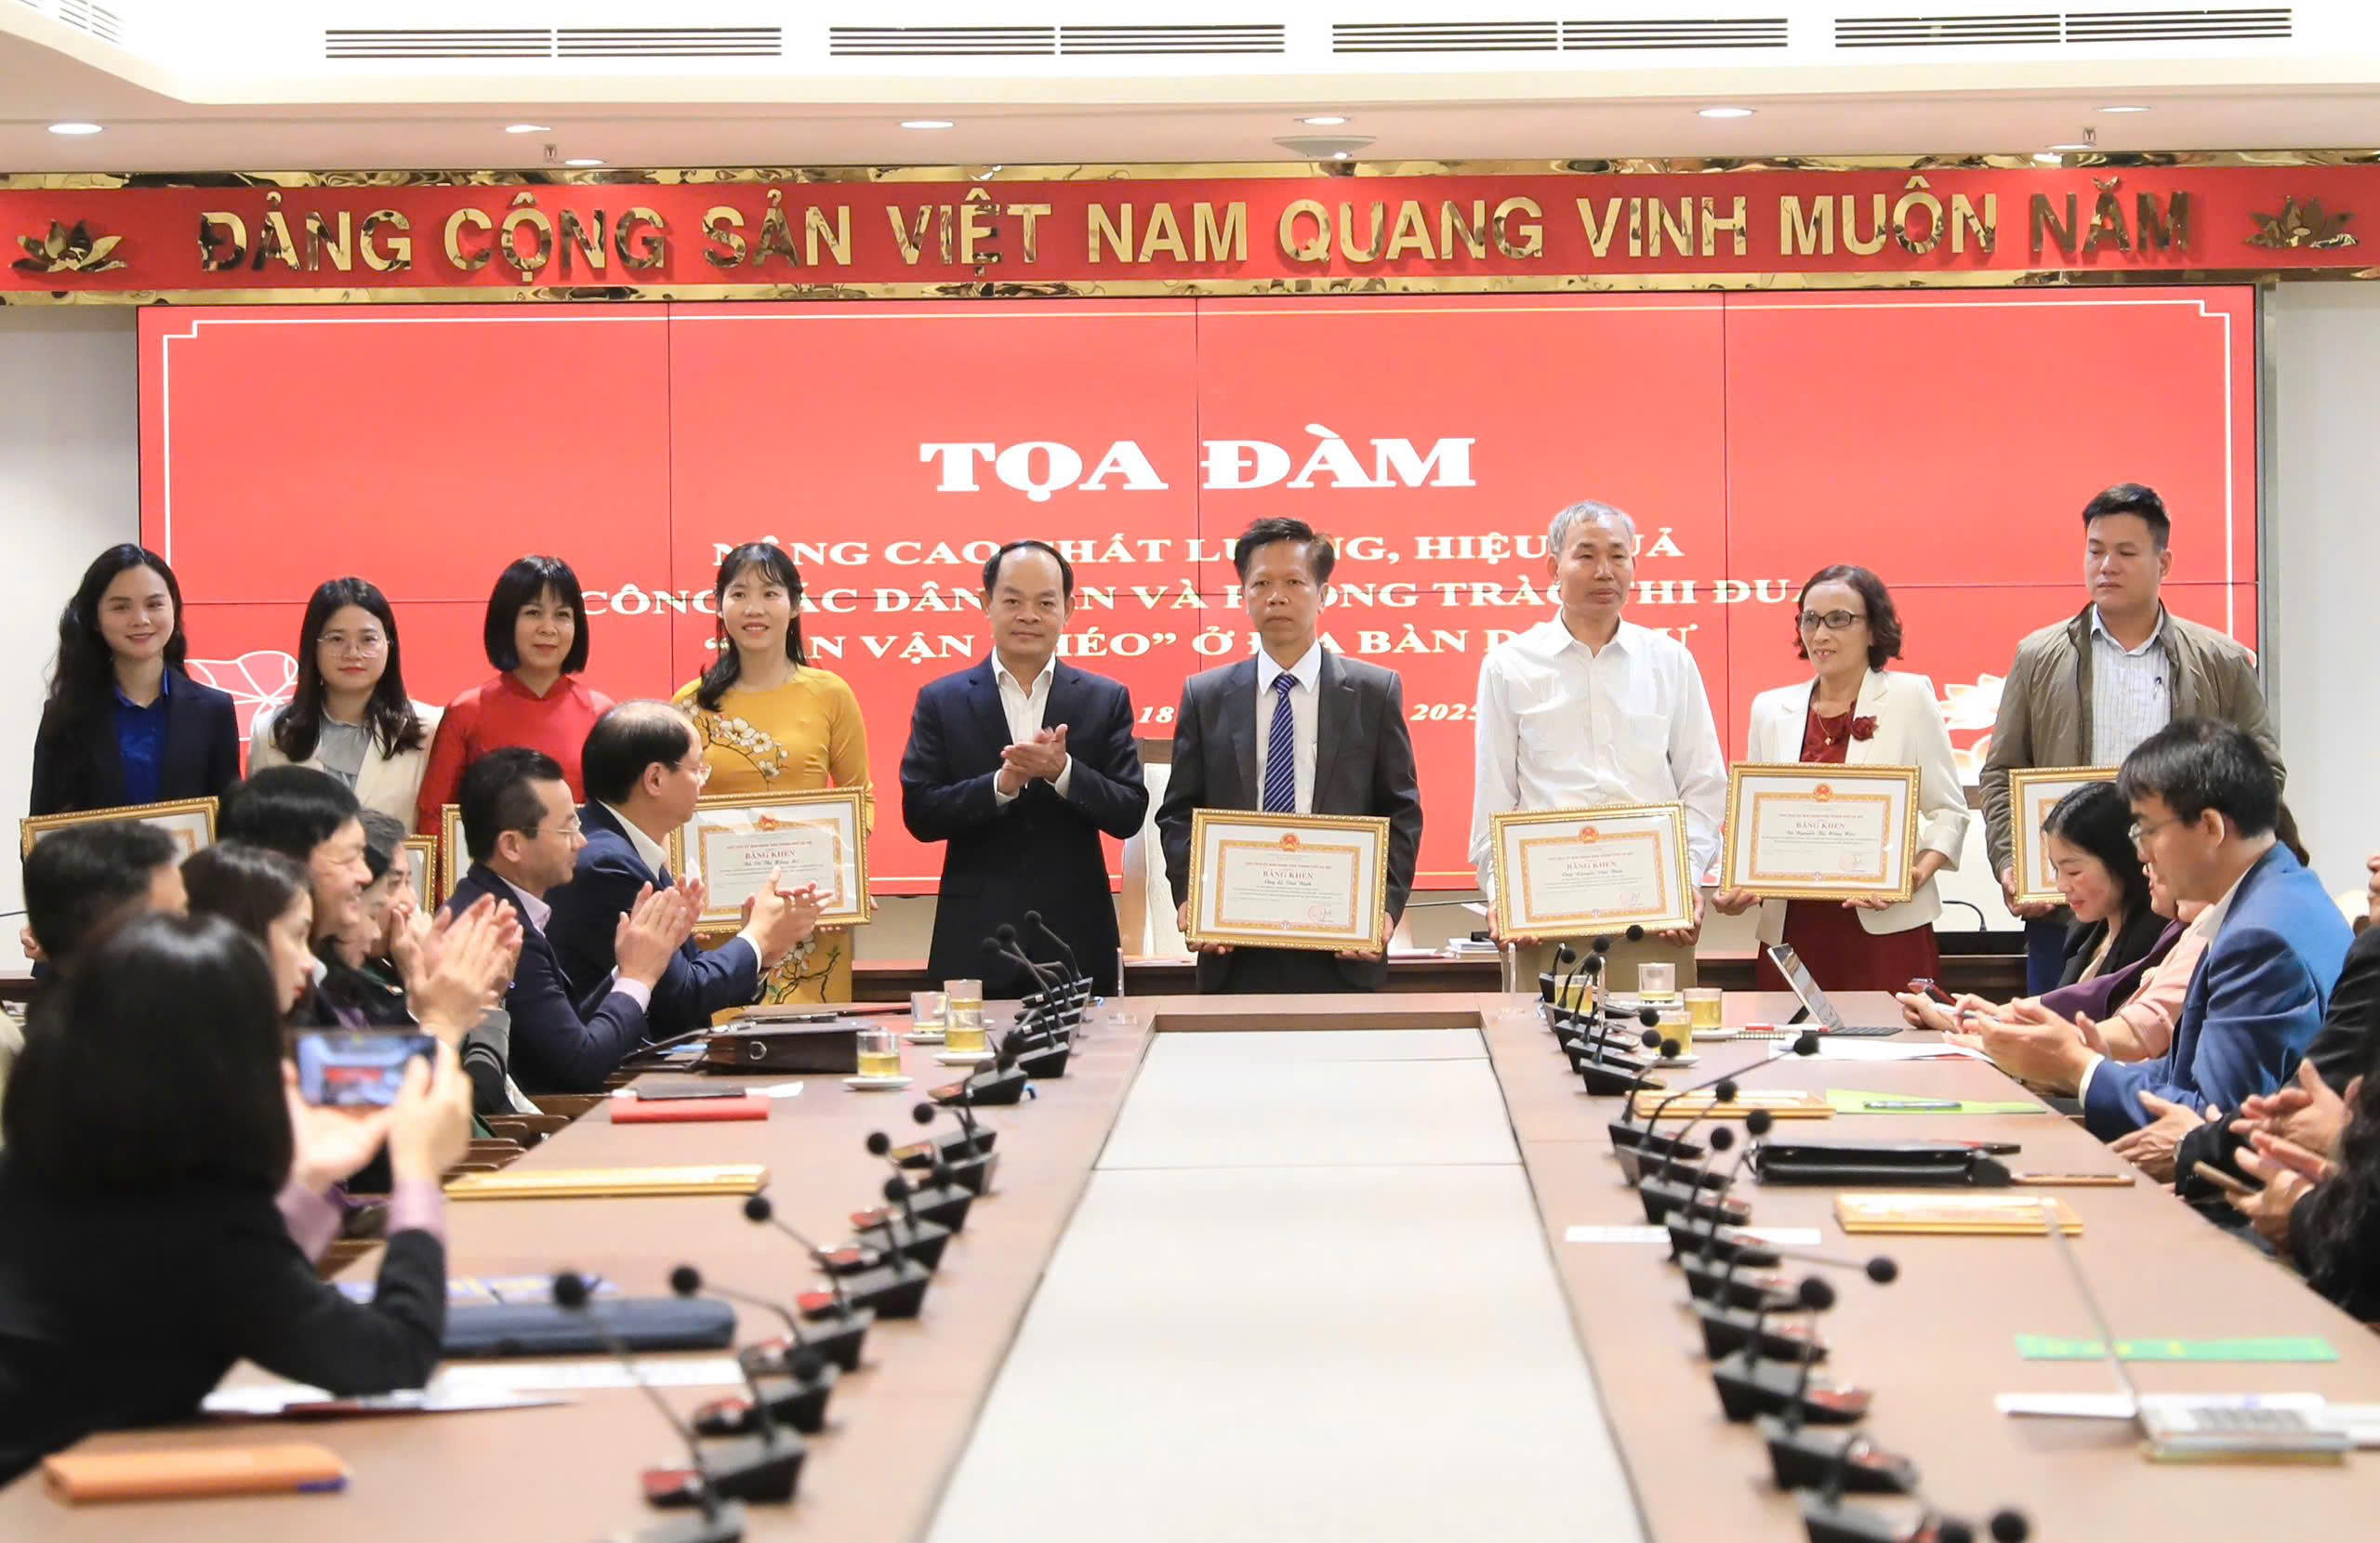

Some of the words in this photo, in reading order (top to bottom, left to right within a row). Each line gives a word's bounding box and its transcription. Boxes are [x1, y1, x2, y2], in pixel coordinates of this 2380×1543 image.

[199, 191, 412, 273] ĐẢNG
[442, 192, 666, 284] CỘNG
[700, 189, 853, 270] SẢN
[885, 188, 1052, 277] VIỆT
[1087, 202, 1249, 266] NAM
[1276, 196, 1544, 266] QUANG
[1576, 195, 1748, 260] VINH
[1779, 177, 1997, 258] MUÔN
[2030, 175, 2191, 256] NĂM
[919, 440, 1169, 502] TỌA
[1199, 423, 1476, 489] ĐÀM
[884, 540, 1002, 565] CAO
[1042, 533, 1171, 563] HẤT
[1415, 531, 1550, 566] HIỆU
[874, 581, 987, 613] DÂN
[1130, 578, 1209, 610] VÀ
[1631, 579, 1699, 606] HI
[859, 631, 974, 666] VẬN
[1191, 626, 1236, 656] Ở
[1356, 623, 1470, 654] BÀN
[1137, 706, 1176, 724] 18
